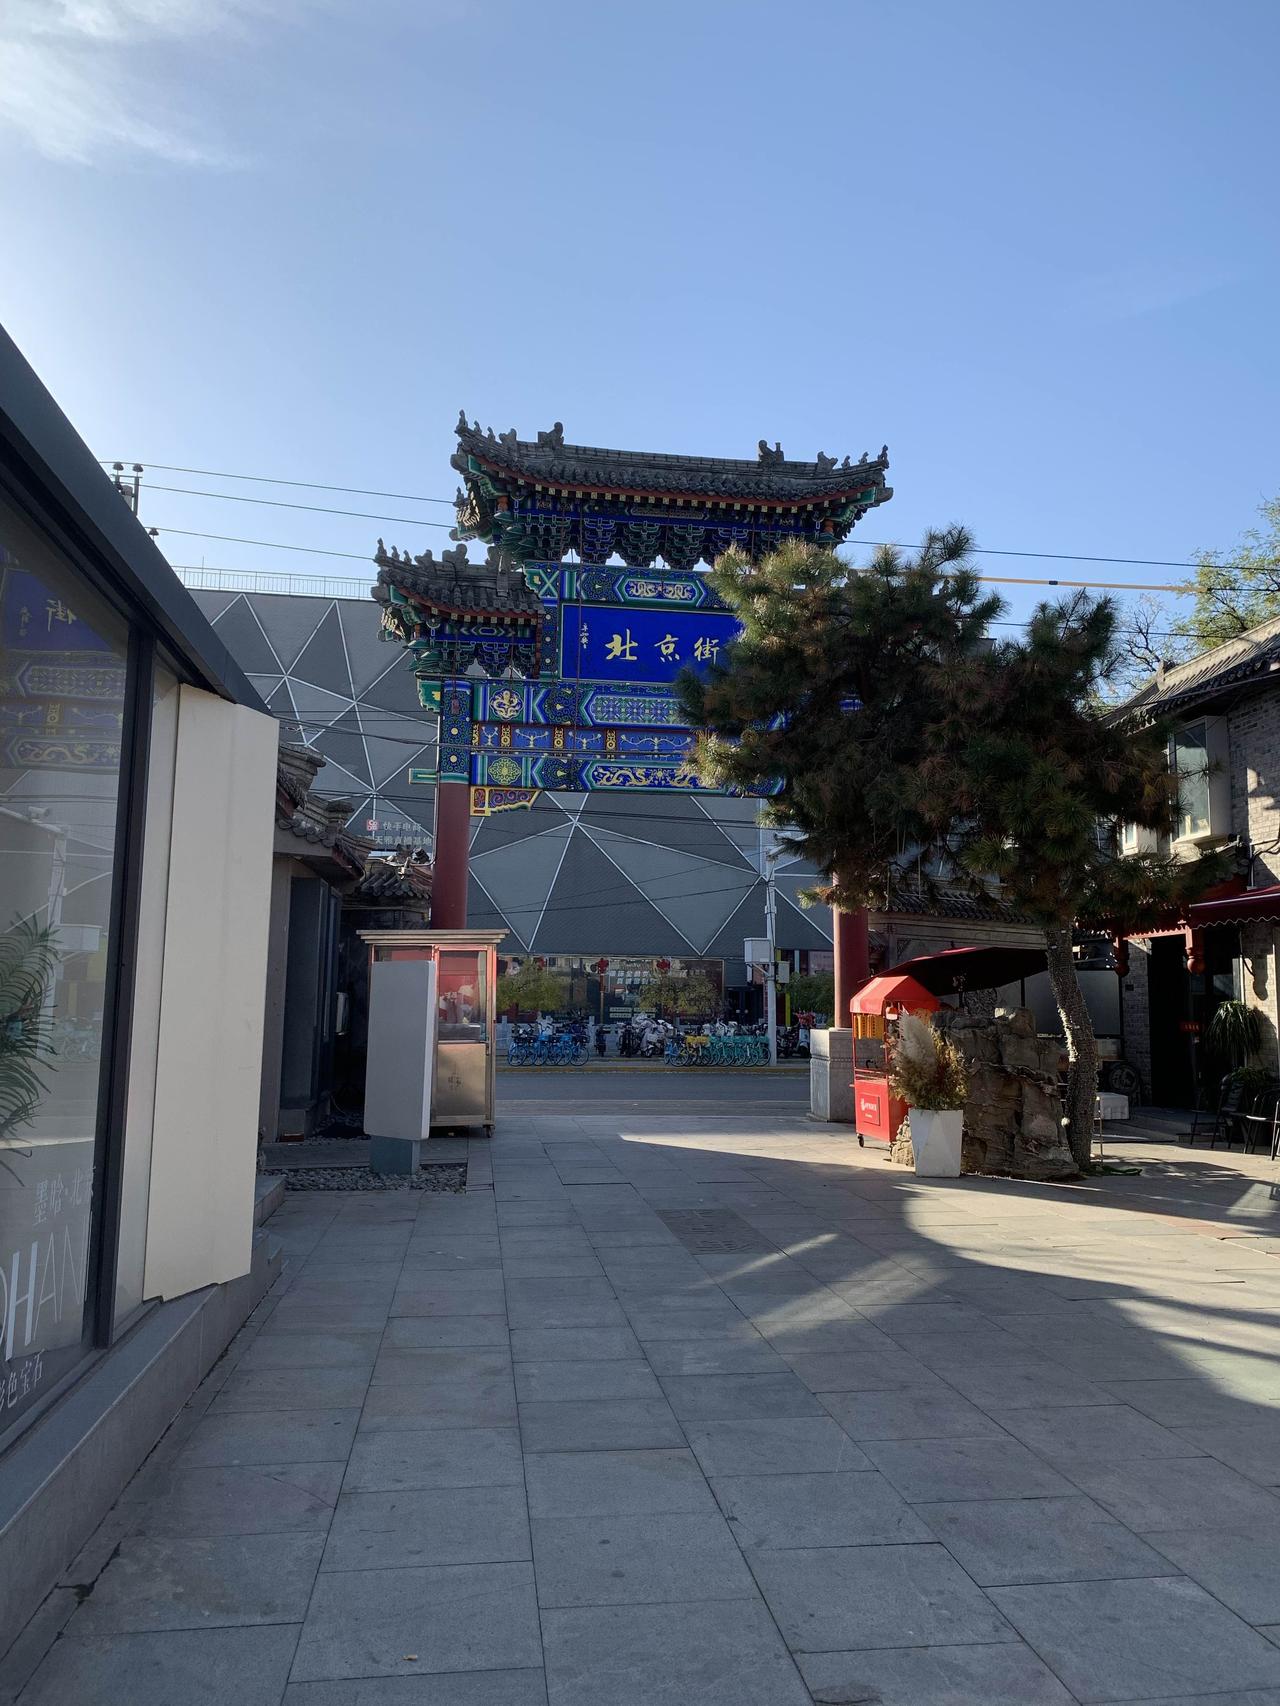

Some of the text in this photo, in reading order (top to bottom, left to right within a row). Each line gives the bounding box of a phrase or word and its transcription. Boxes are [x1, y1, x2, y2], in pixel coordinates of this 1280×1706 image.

[605, 628, 720, 664] 北京街
[383, 821, 421, 832] 快手电商
[0, 1211, 93, 1362] HAN
